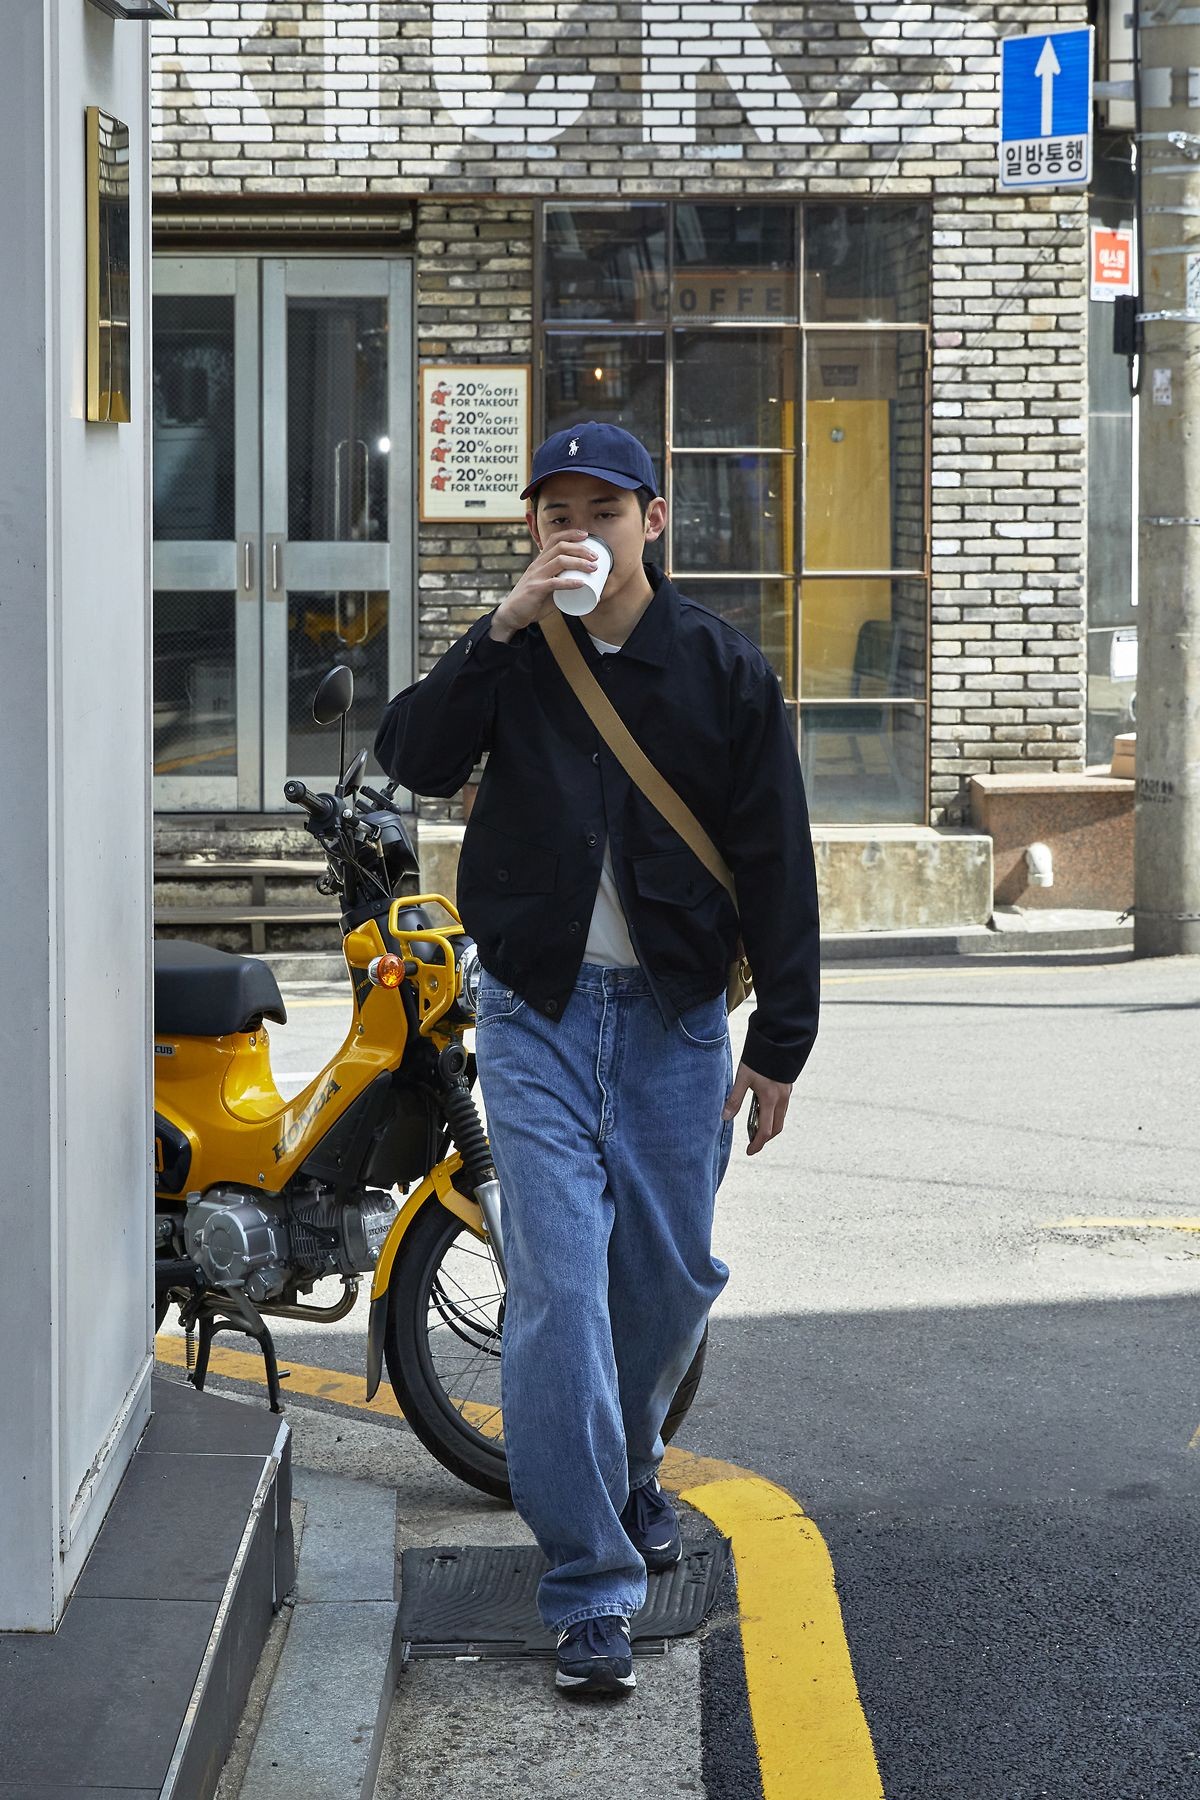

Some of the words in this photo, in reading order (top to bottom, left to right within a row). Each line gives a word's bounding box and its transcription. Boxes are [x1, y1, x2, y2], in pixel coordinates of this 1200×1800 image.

[1006, 139, 1083, 176] 일방통행
[456, 383, 492, 396] 20%
[494, 388, 518, 396] OFF!
[451, 398, 471, 407] FOR
[473, 398, 519, 407] TAKEOUT
[456, 411, 492, 425] 20%
[494, 416, 518, 425] OFF!
[451, 426, 471, 435] FOR
[473, 426, 519, 435] TAKEOUT
[456, 440, 492, 453] 20%
[494, 445, 518, 453] OFF!
[451, 455, 471, 464] FOR
[473, 455, 519, 464] TAKEOUT
[456, 468, 492, 481] 20%
[494, 473, 518, 481] OFF!
[451, 483, 471, 492] FOR
[473, 483, 519, 492] TAKEOUT
[272, 1079, 341, 1164] HONDA
